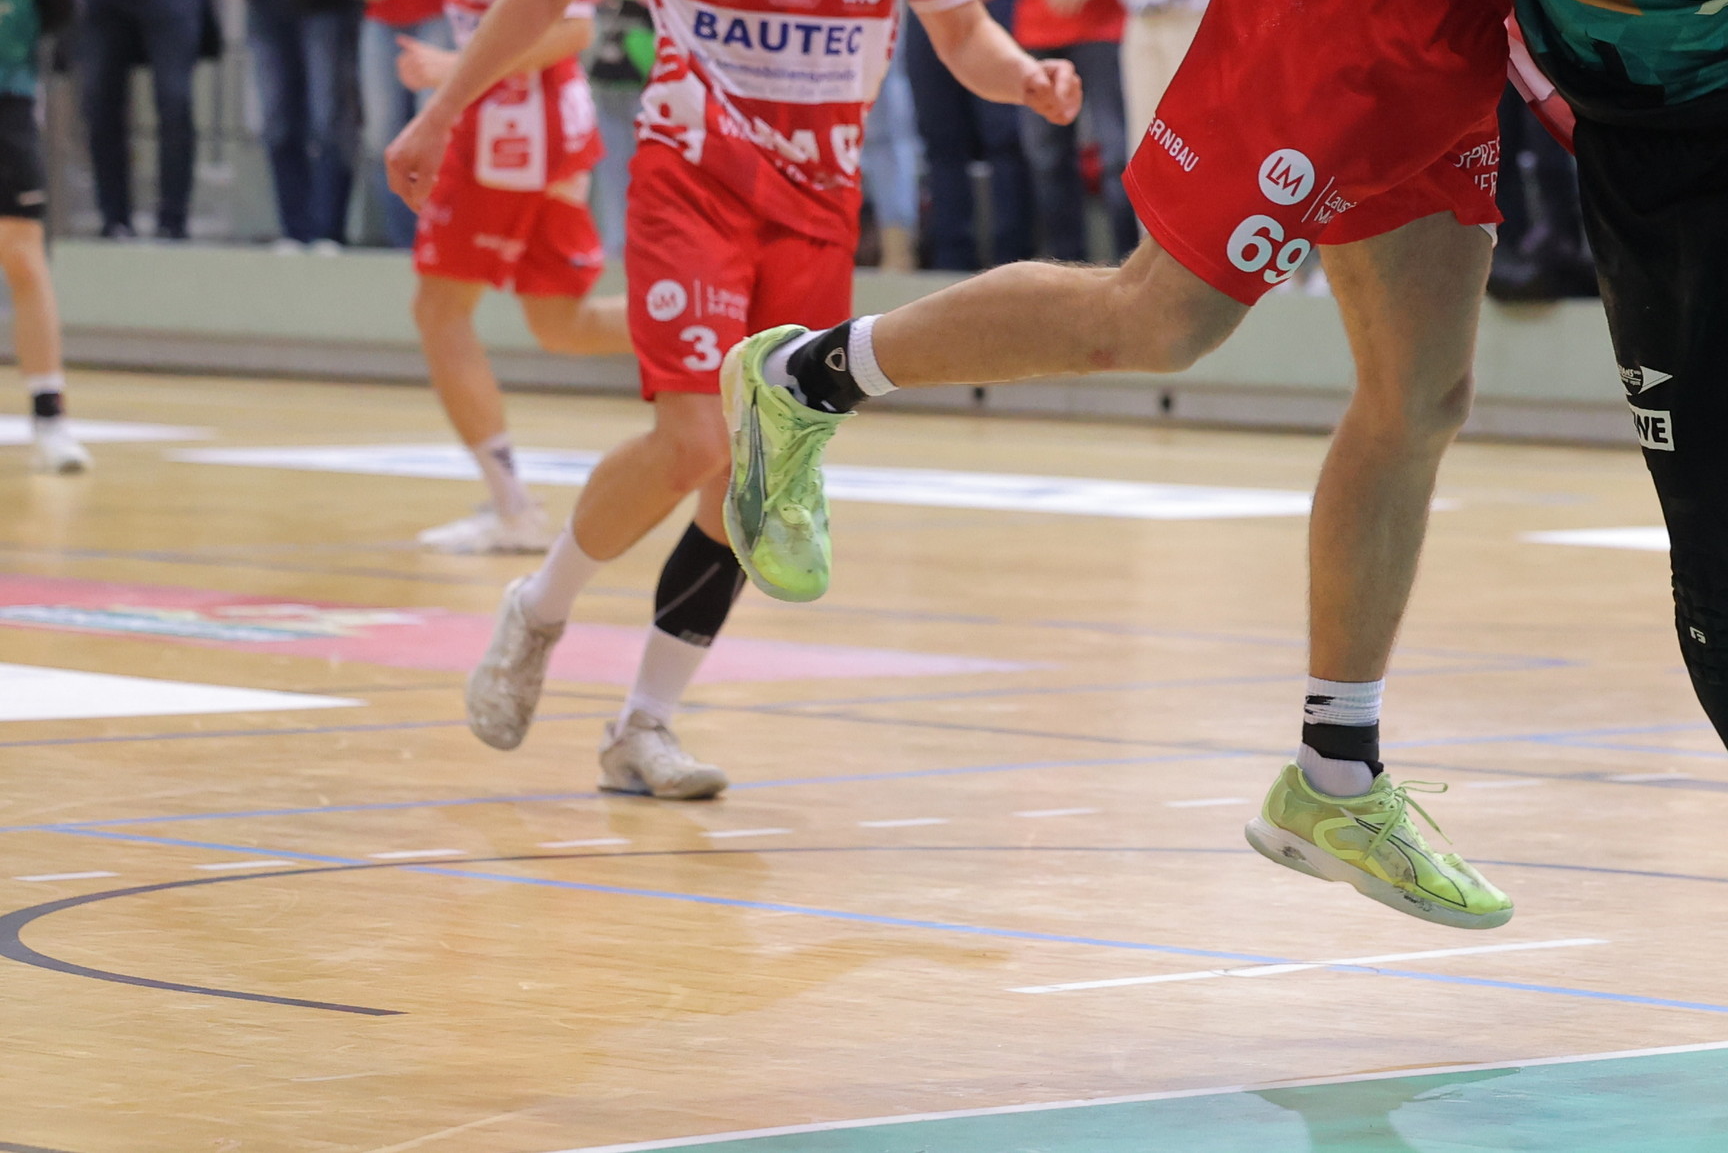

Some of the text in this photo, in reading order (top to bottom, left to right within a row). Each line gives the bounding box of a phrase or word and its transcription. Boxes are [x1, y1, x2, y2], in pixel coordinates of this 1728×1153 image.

[693, 9, 864, 56] BAUTEC
[1265, 155, 1306, 198] LM
[1324, 190, 1357, 214] Laus
[1226, 214, 1311, 284] 69
[679, 324, 723, 372] 3
